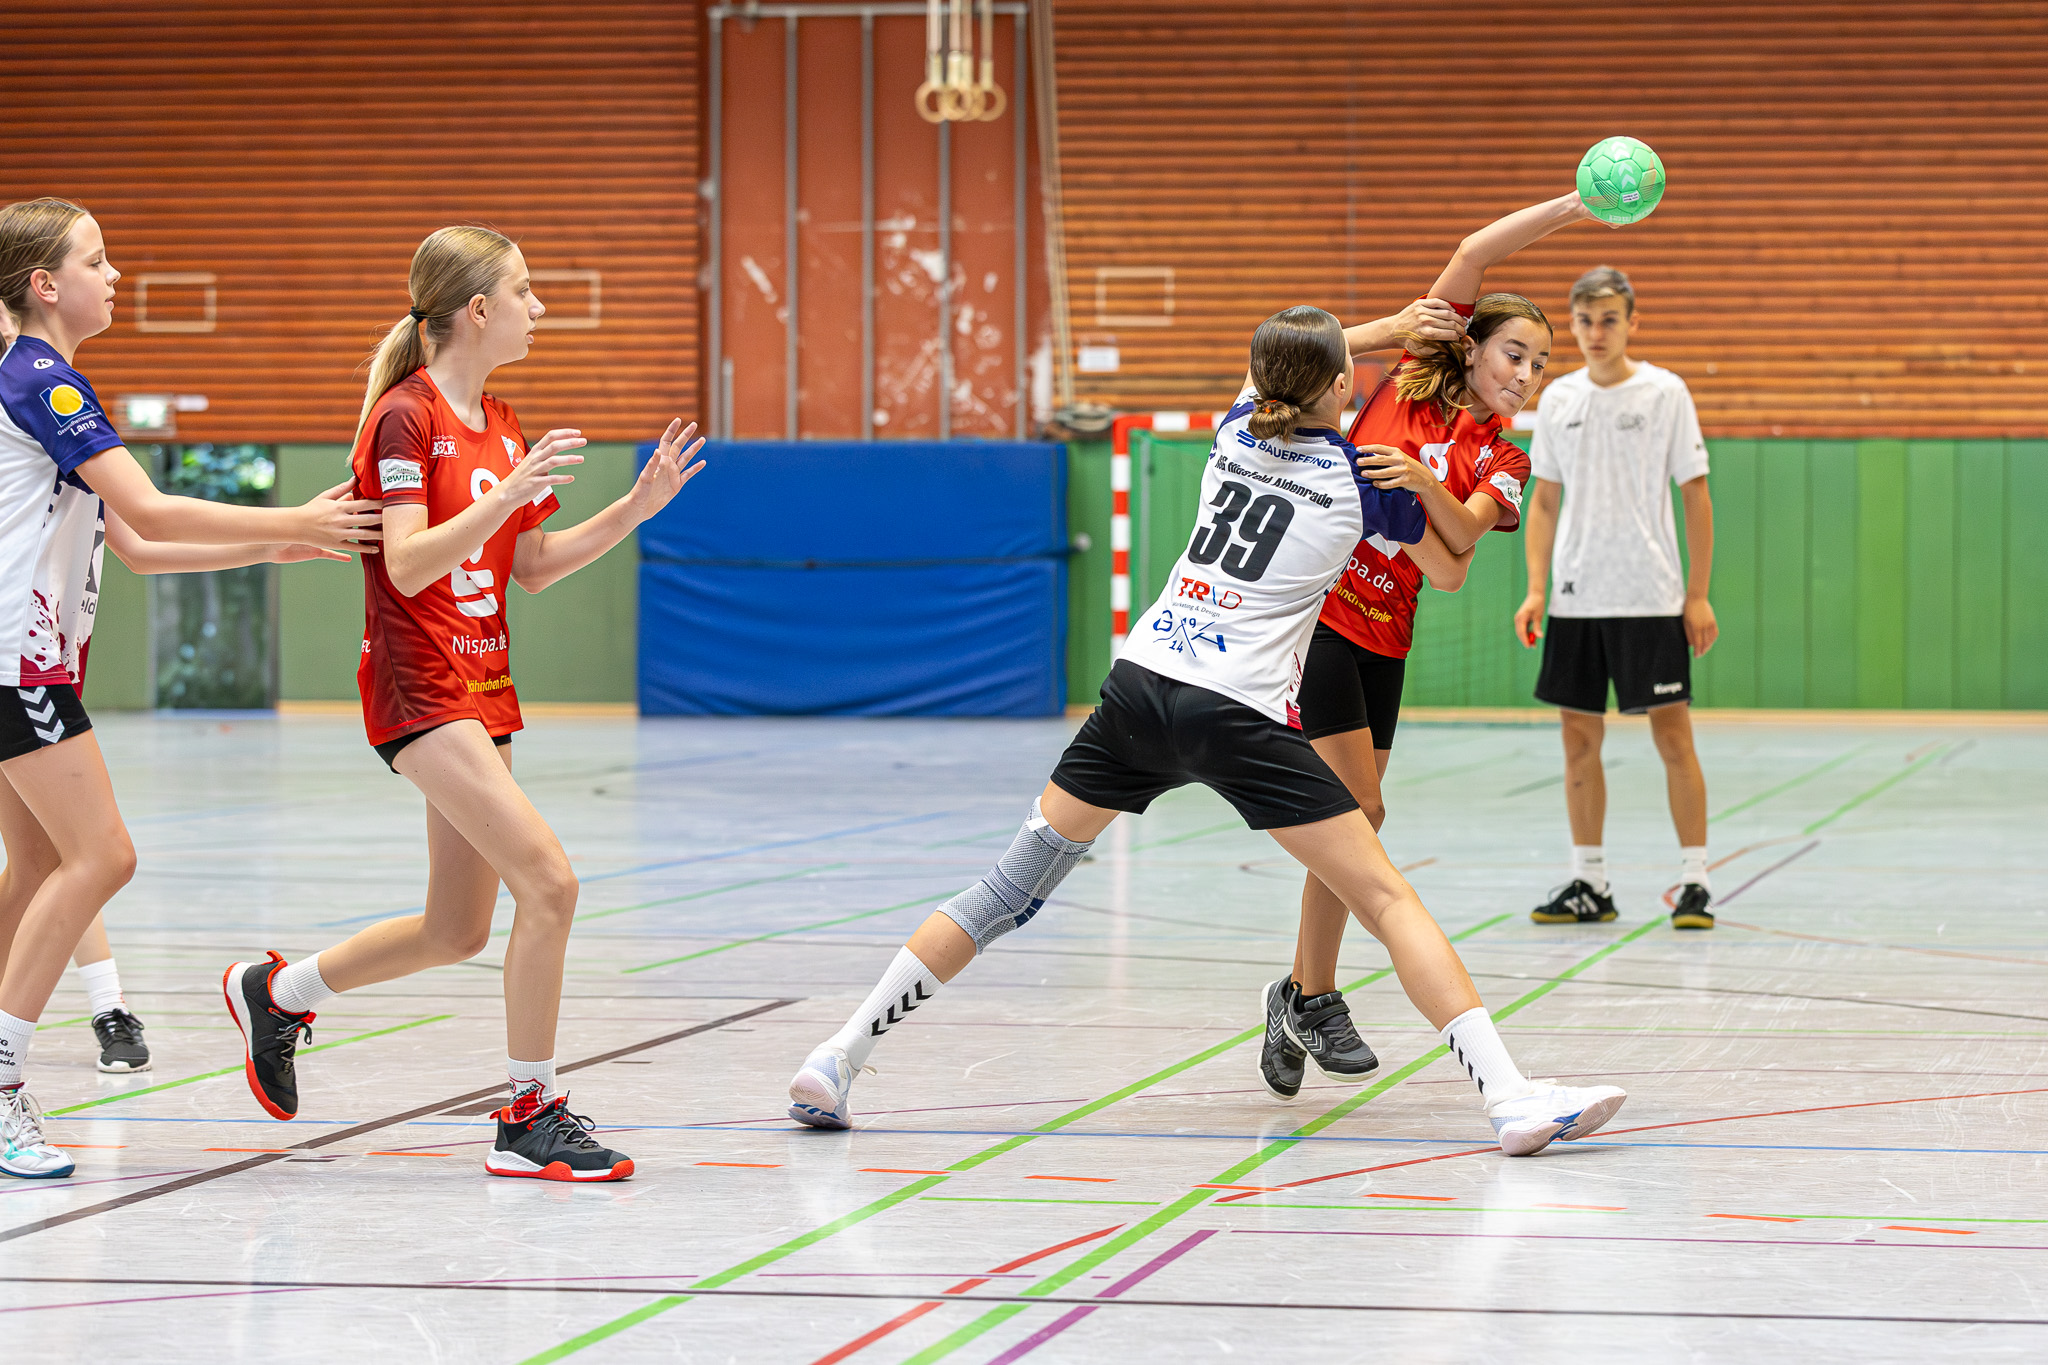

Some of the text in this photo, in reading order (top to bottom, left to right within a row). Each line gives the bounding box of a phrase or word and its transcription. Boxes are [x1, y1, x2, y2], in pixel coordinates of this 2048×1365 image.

[70, 419, 97, 437] Lang
[1271, 477, 1334, 509] Aldenrade
[1187, 481, 1295, 582] 39
[1200, 606, 1221, 618] Design
[452, 630, 507, 658] Nispa.de
[1169, 640, 1184, 653] 14
